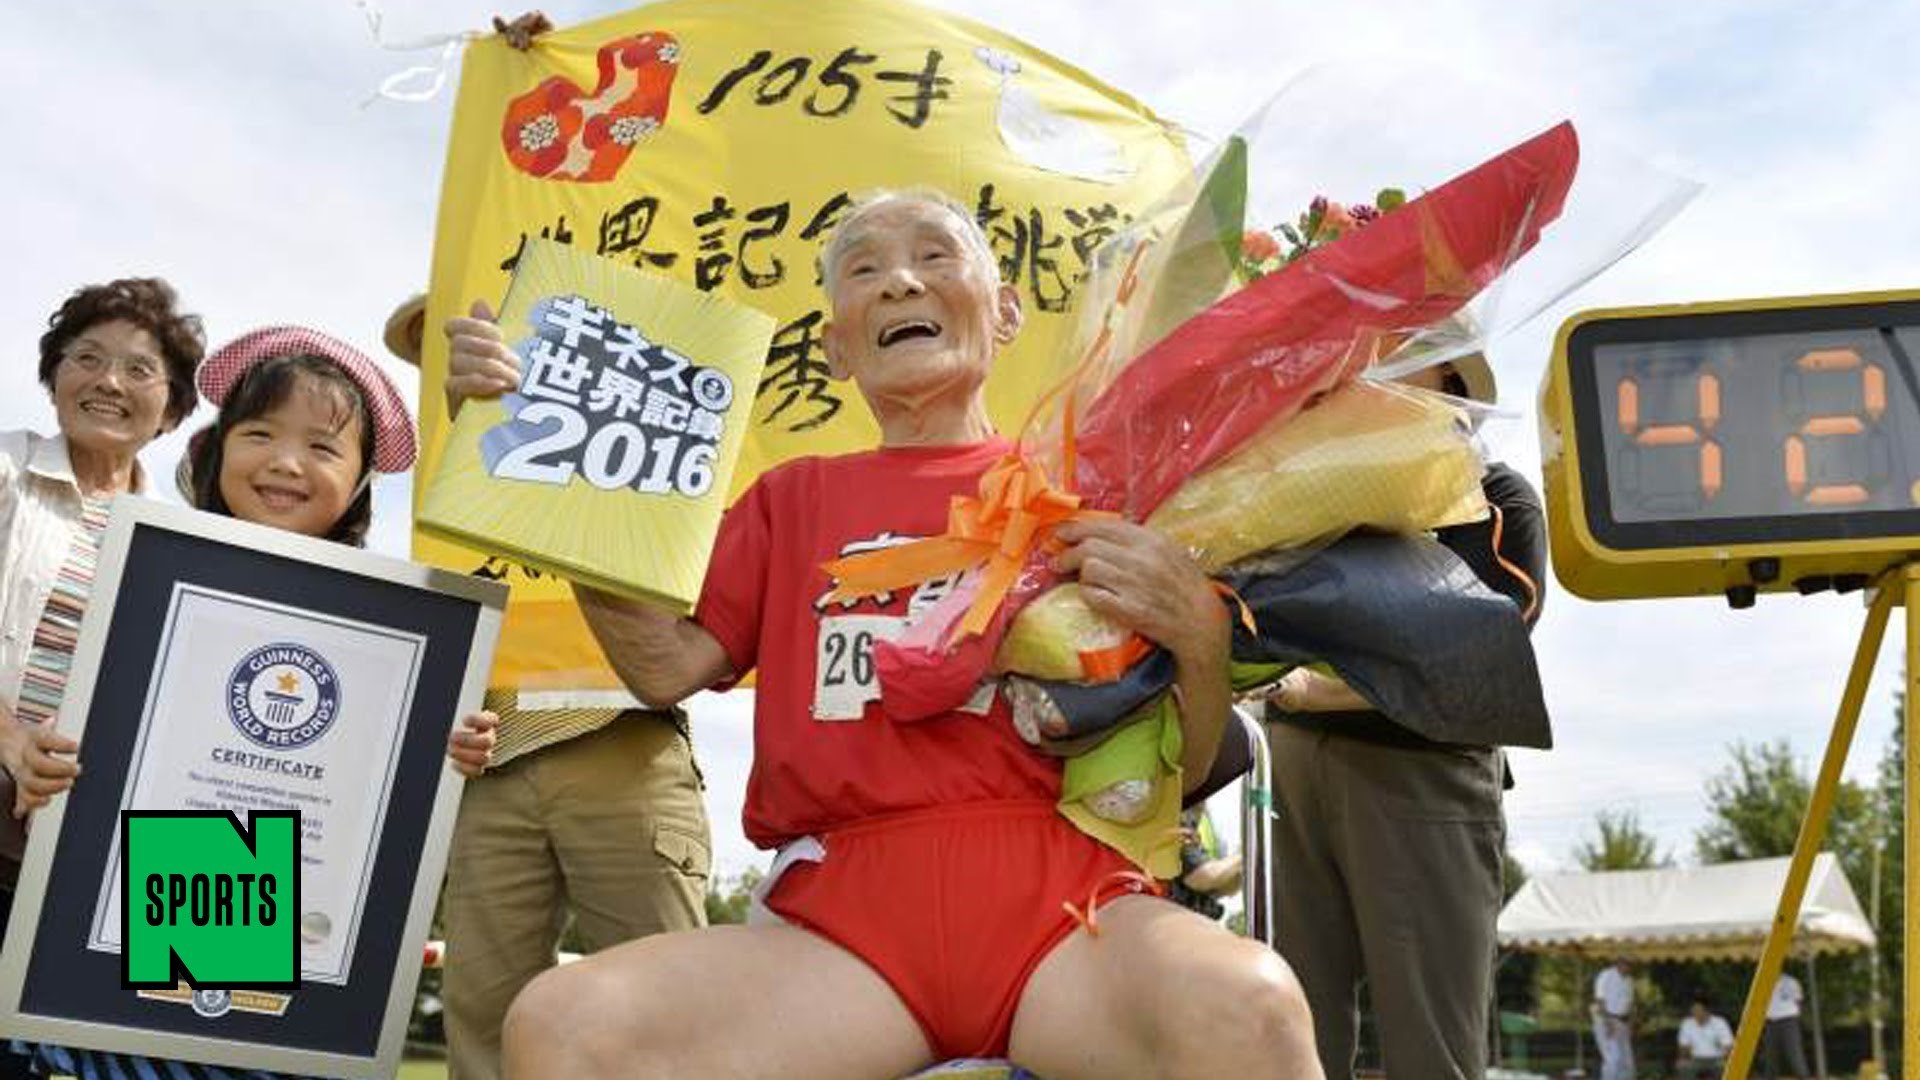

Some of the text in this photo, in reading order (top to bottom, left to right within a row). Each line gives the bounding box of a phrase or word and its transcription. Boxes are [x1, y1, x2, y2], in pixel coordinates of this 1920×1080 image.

[544, 296, 692, 394] ギネス
[492, 401, 719, 499] 2016
[1617, 350, 1889, 505] 42
[249, 649, 331, 685] GUINNESS
[233, 682, 334, 744] WORLD RECORDS
[211, 748, 325, 780] CERTIFICATE
